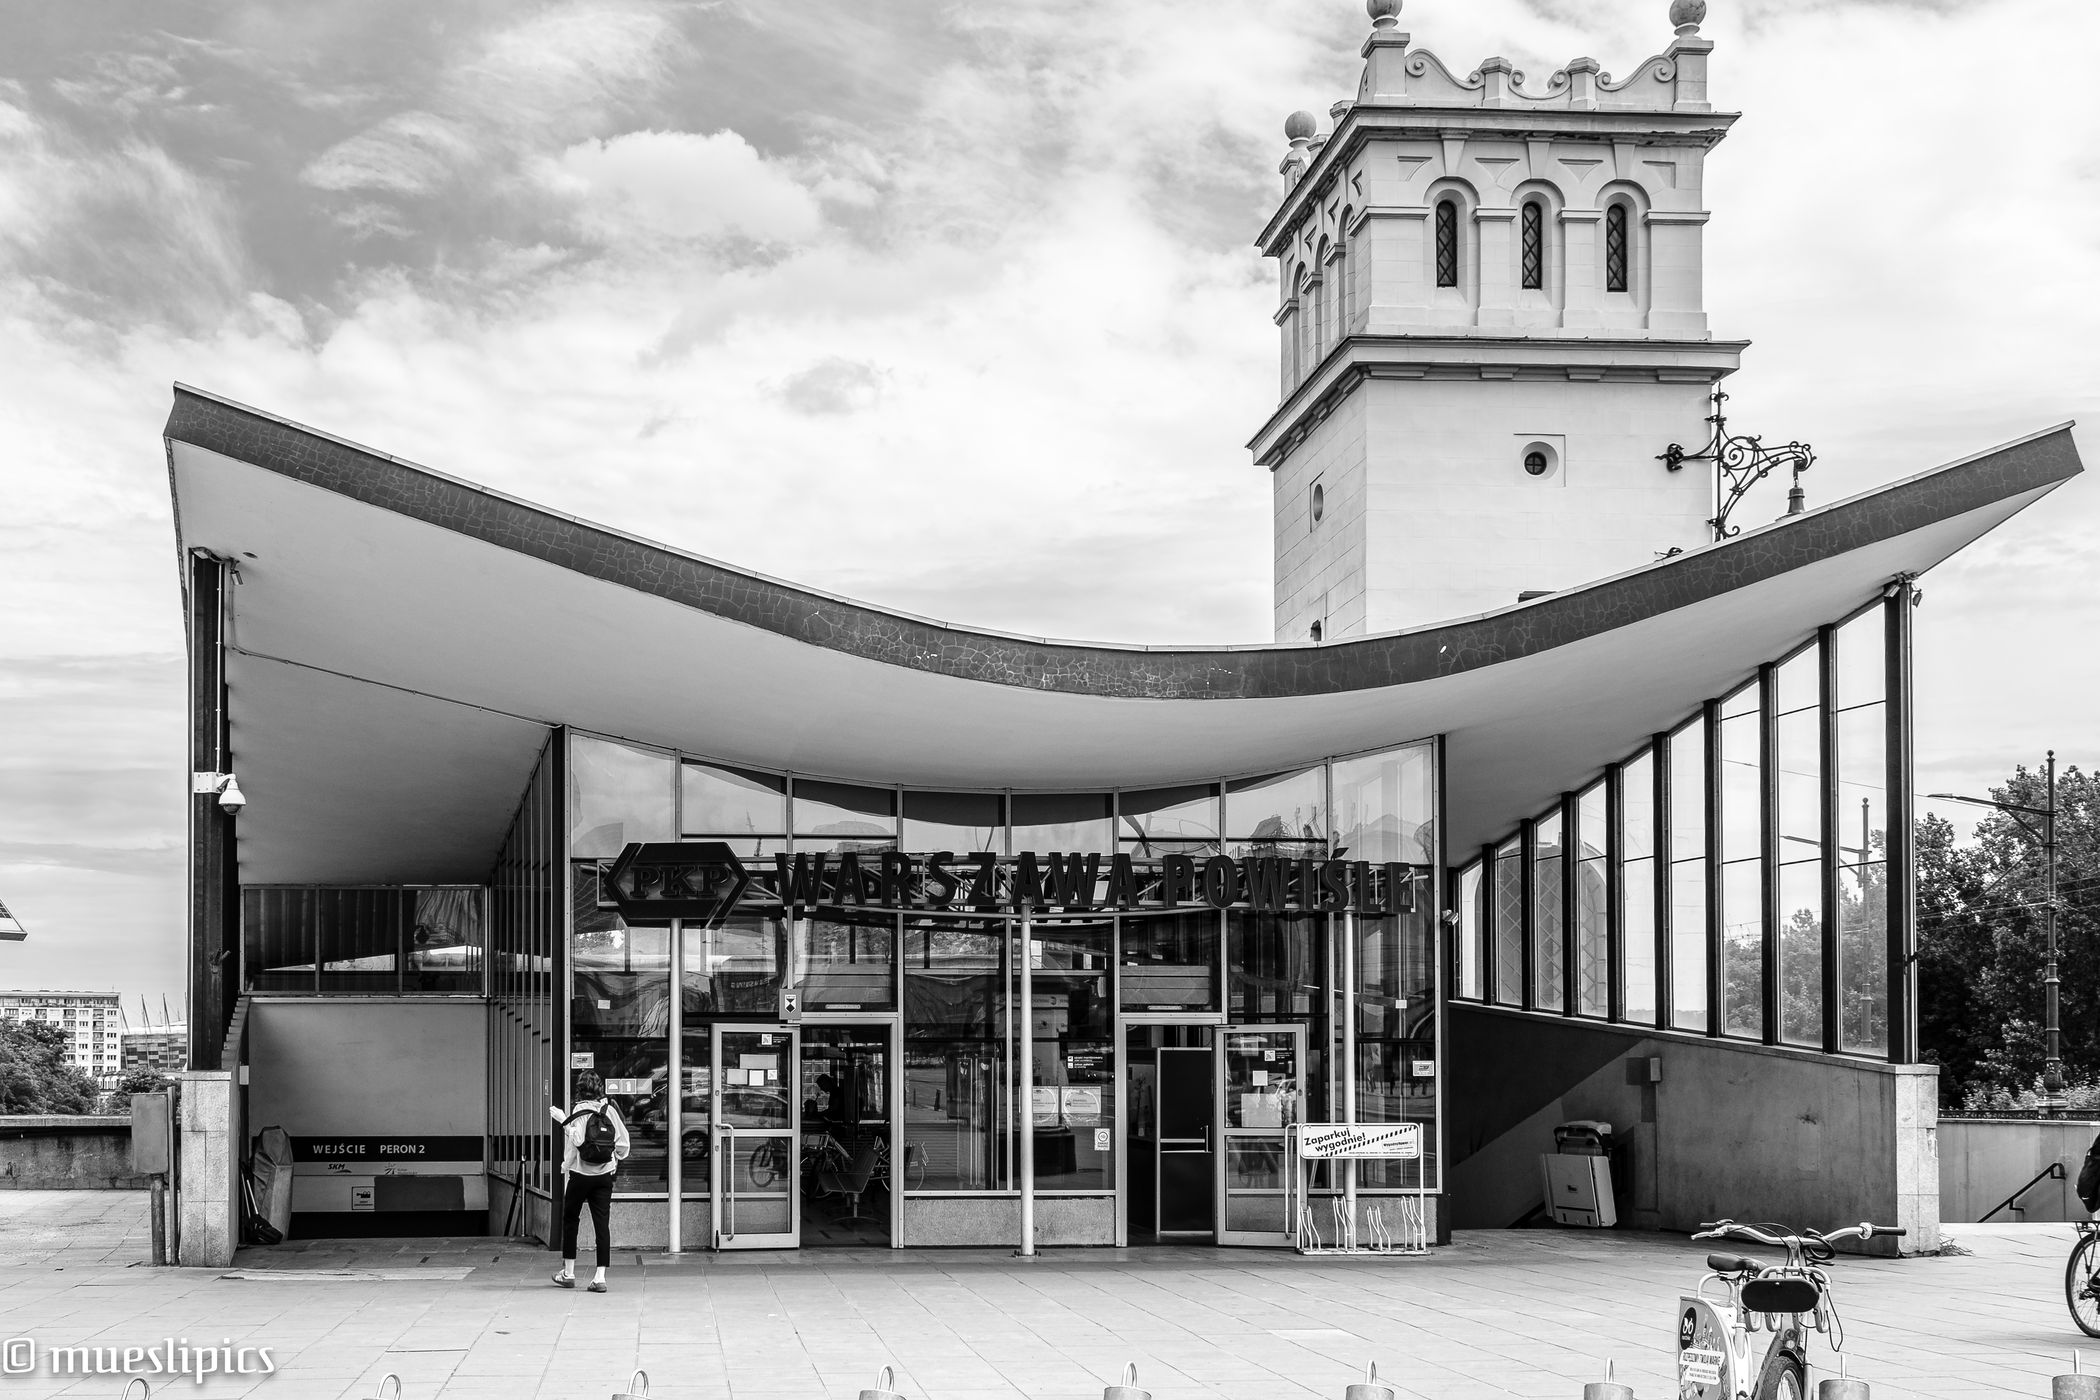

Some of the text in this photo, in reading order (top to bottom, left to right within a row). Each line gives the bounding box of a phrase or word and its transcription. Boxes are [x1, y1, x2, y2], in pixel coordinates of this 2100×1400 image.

[629, 865, 732, 899] PKP
[774, 847, 1413, 914] WARSZAWA POWIŚLE
[1304, 1128, 1351, 1146] Zaparkuj
[1315, 1132, 1366, 1153] wygodnie!
[313, 1142, 425, 1154] WEJŚCIE PERON 2
